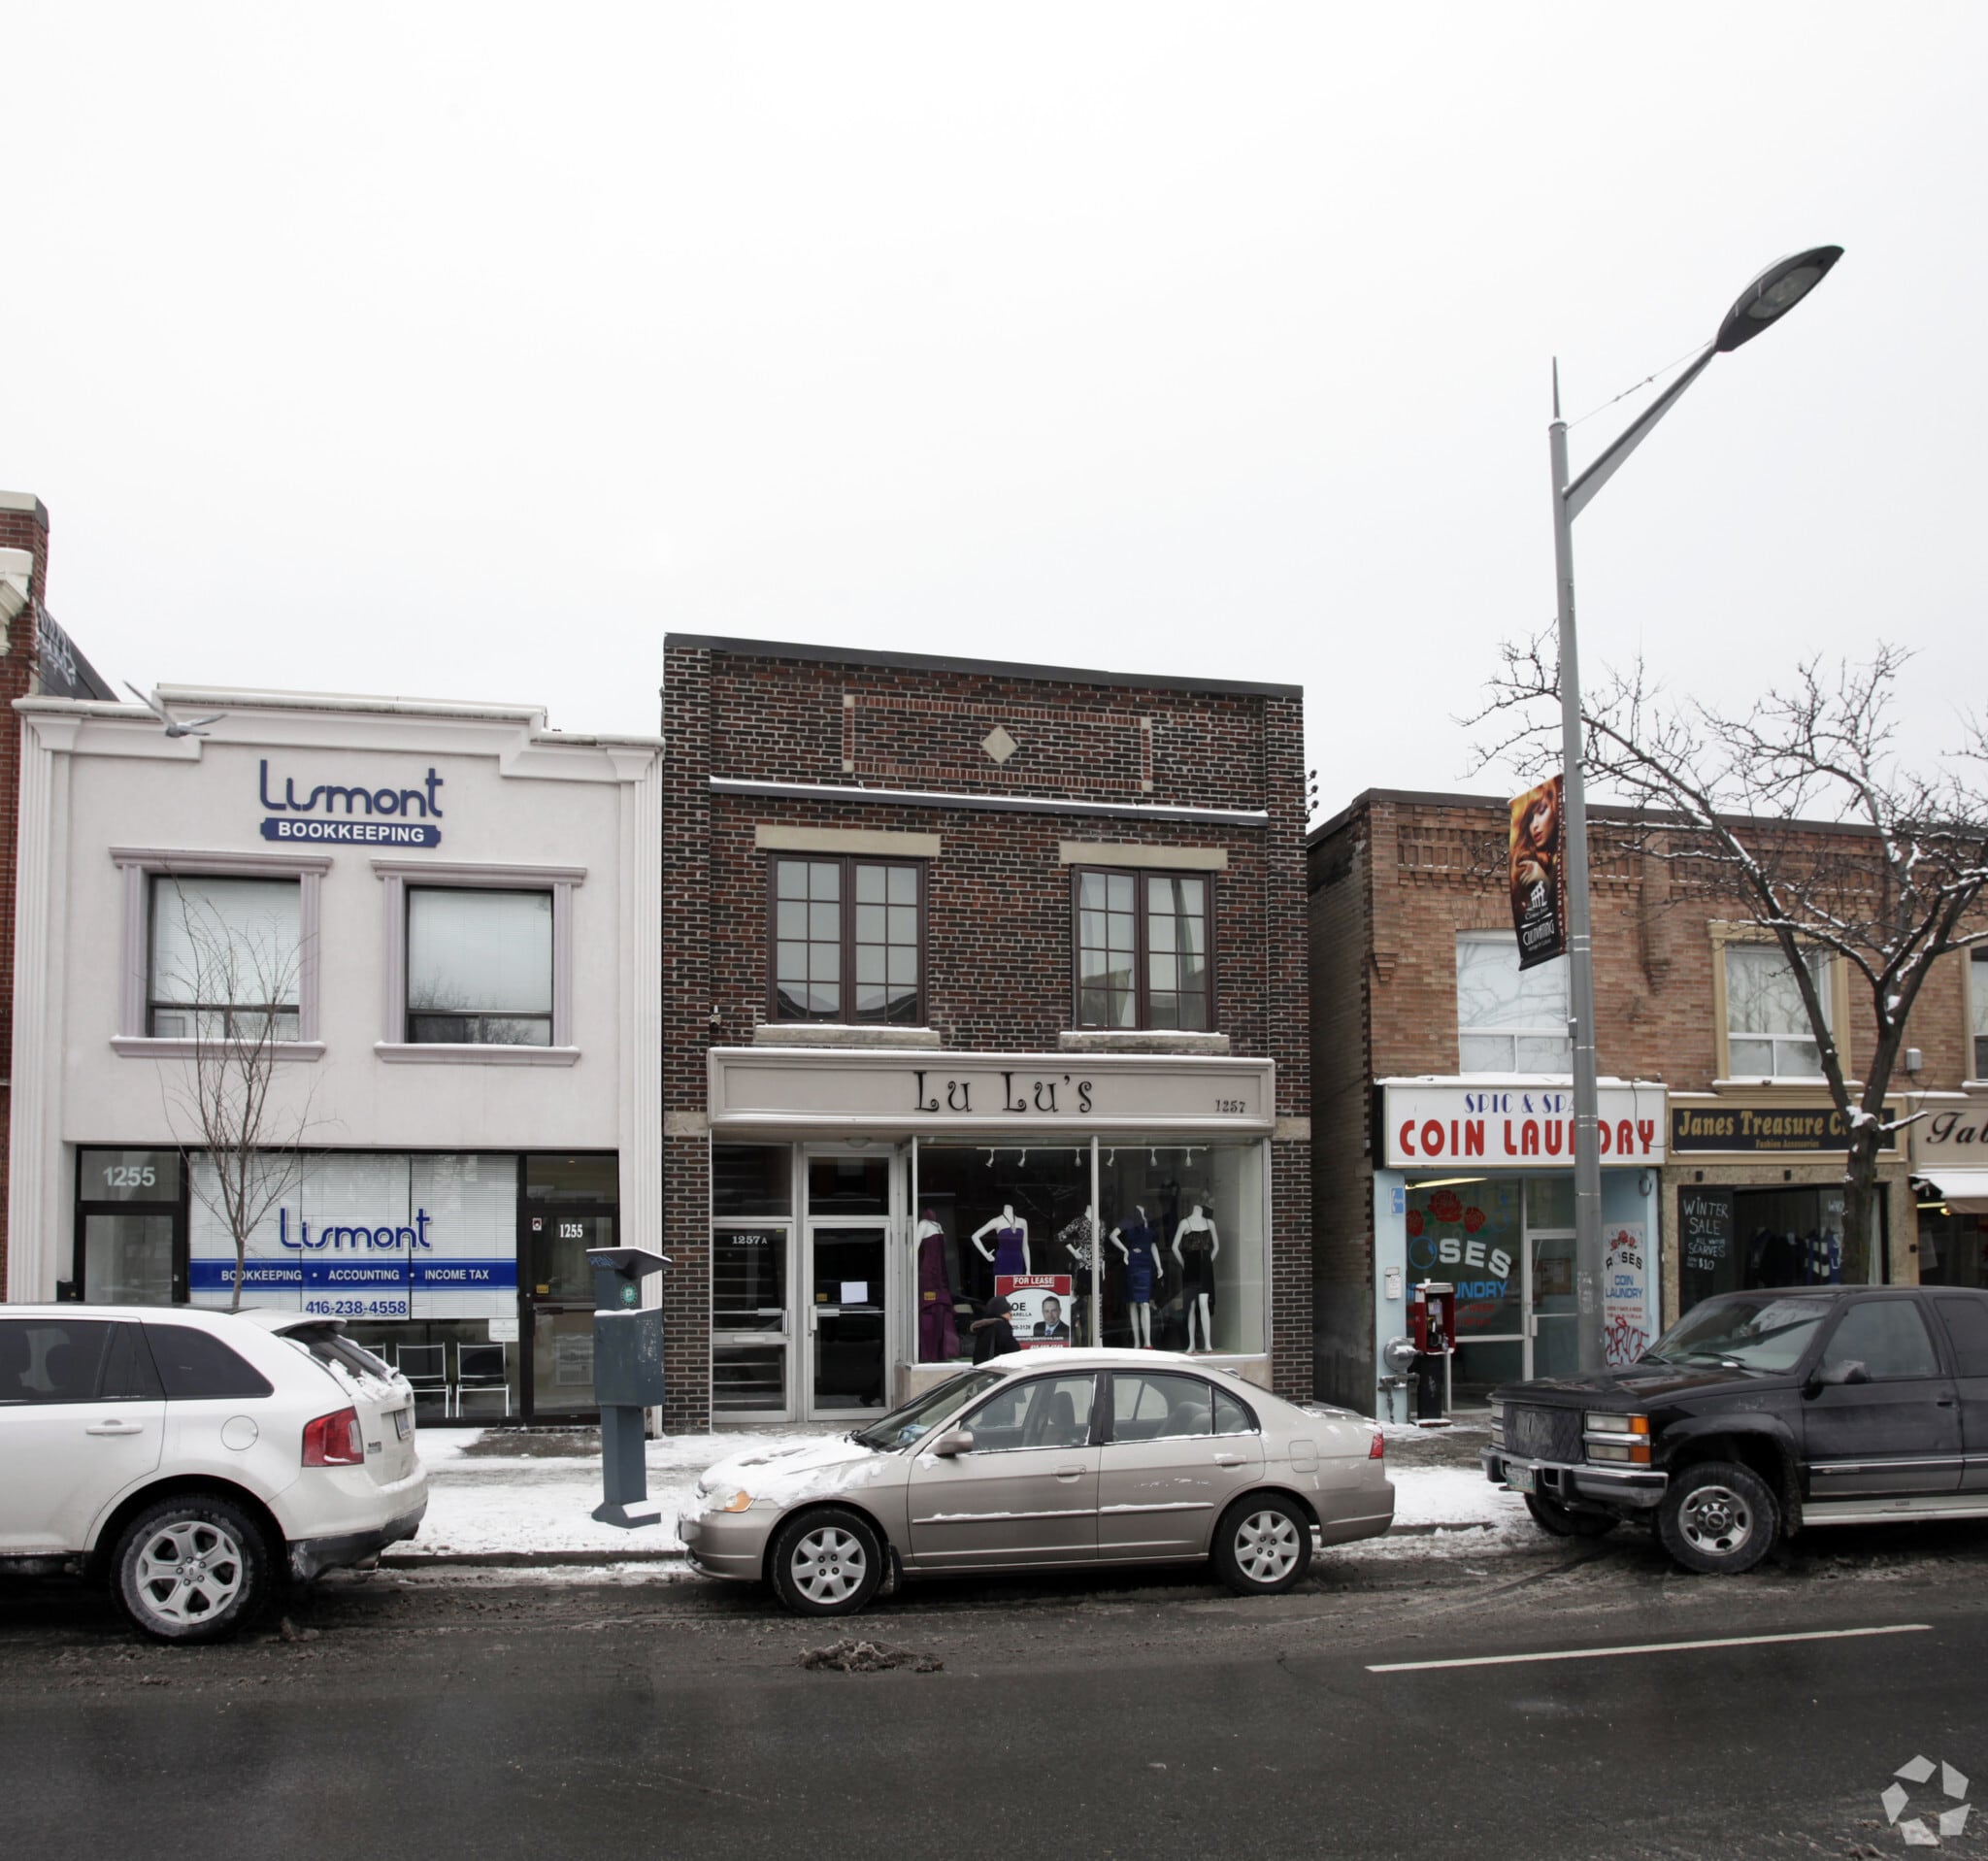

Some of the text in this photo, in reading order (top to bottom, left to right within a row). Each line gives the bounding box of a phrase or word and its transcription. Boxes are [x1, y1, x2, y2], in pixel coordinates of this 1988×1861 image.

[260, 759, 444, 817] Lismont
[278, 821, 425, 843] BOOKKEEPING
[913, 1071, 1092, 1113] Lu Lu's
[1215, 1099, 1246, 1113] 1257
[1464, 1093, 1513, 1113] SPIC
[1521, 1093, 1534, 1113] &
[1678, 1111, 1734, 1136] Janes
[1740, 1111, 1823, 1135] Treasure
[1399, 1119, 1654, 1156] COIN LAUDRY
[103, 1167, 156, 1186] 1255
[281, 1208, 431, 1249] Lismont
[560, 1223, 583, 1238] 1255
[1689, 1217, 1721, 1236] SALE
[328, 1270, 400, 1279] ACCOUNTING
[425, 1270, 466, 1279] INCOME
[469, 1270, 489, 1279] TAX
[1614, 1275, 1634, 1286] COIN
[1606, 1287, 1643, 1299] LAUNDRY
[306, 1300, 406, 1313] 416-238-4558
